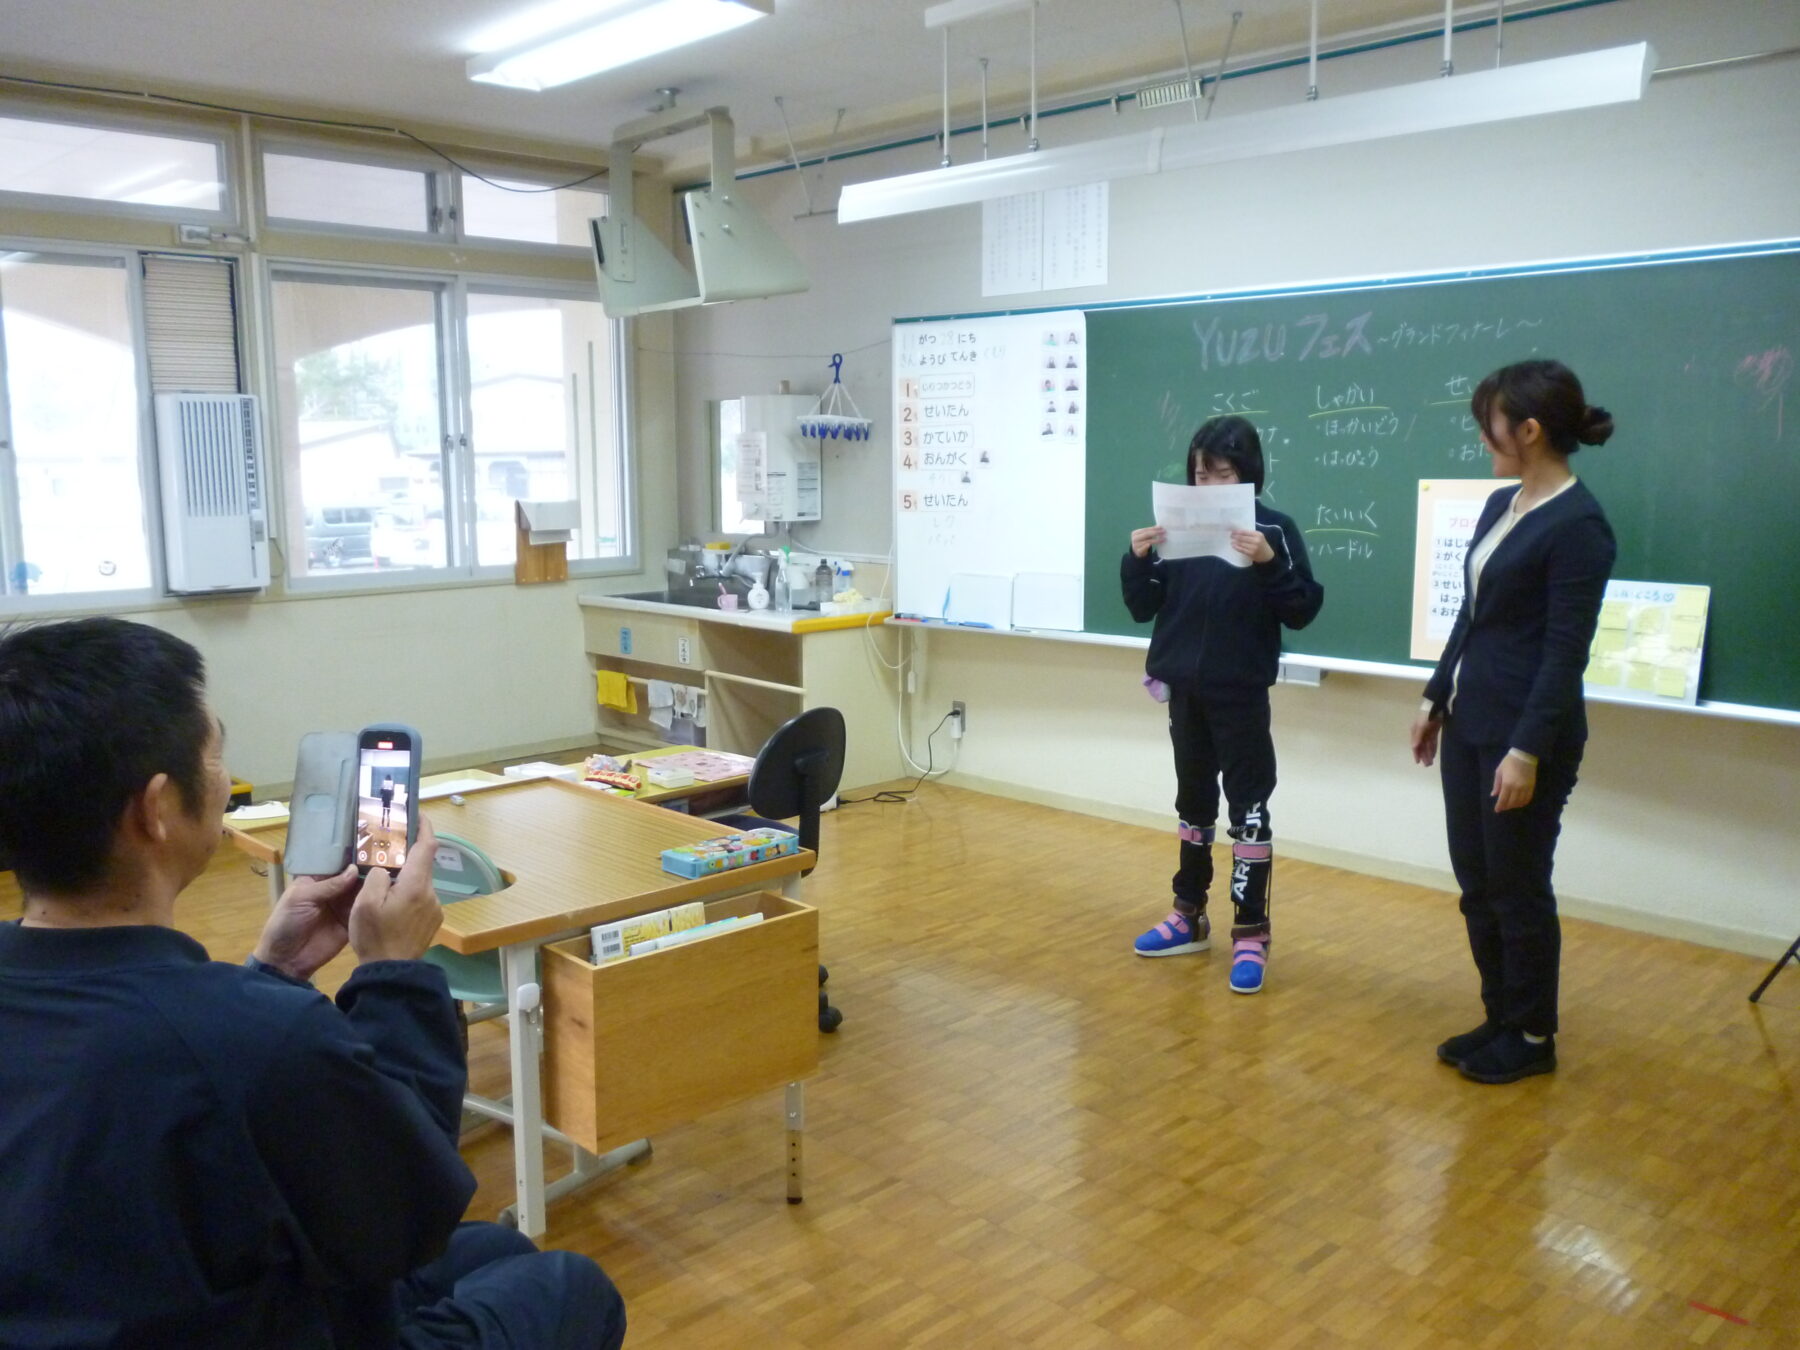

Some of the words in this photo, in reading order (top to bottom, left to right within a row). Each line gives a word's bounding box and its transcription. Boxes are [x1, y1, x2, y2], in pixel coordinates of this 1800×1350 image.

[918, 333, 937, 346] がつ
[957, 332, 977, 345] にち
[1192, 316, 1287, 371] YUZU
[1296, 311, 1373, 362] フェス
[919, 352, 947, 367] ようび
[950, 349, 977, 363] てんき
[1211, 388, 1260, 413] こくご
[1316, 382, 1375, 410] しゃかい
[903, 407, 913, 422] 2
[924, 404, 969, 418] せいたん
[903, 431, 913, 446] 3
[923, 430, 969, 444] かていか
[903, 454, 913, 470] 4
[924, 452, 967, 466] おんがく
[903, 494, 913, 510] 5
[924, 494, 969, 507] せいたん
[1316, 500, 1378, 529] たいいく
